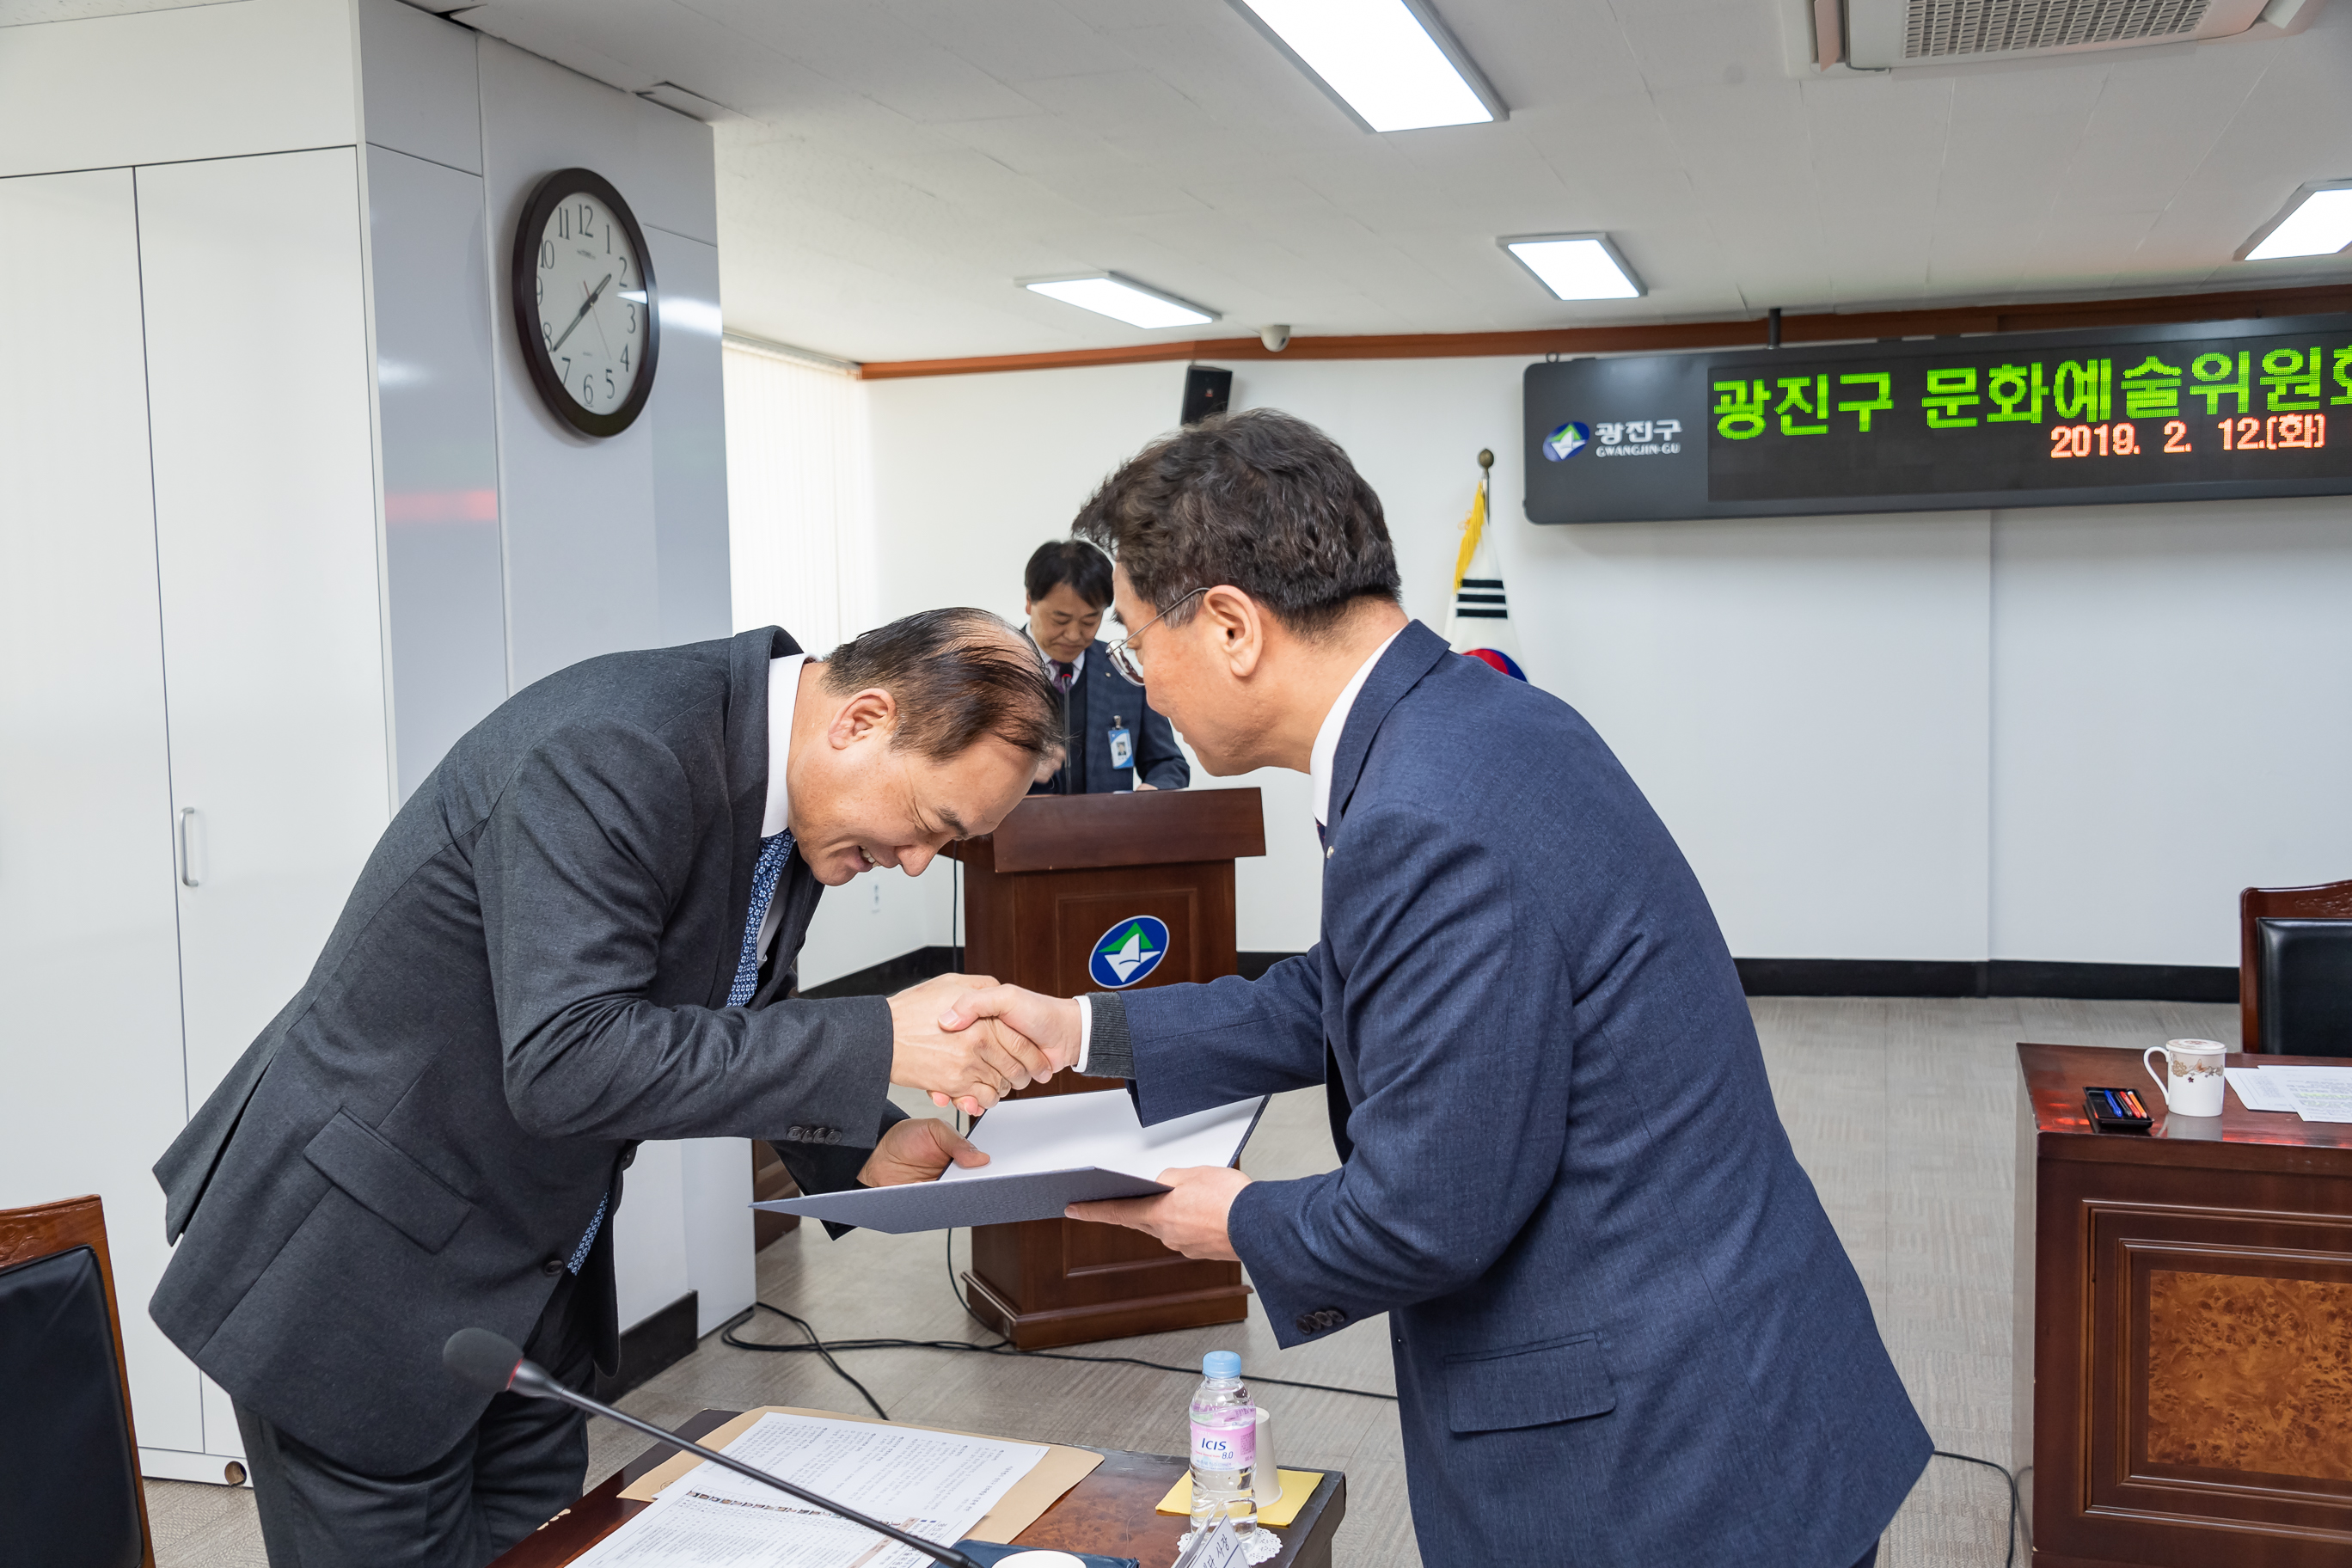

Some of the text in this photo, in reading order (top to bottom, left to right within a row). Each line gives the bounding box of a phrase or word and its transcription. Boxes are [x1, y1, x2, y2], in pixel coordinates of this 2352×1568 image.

[558, 205, 570, 241] 11
[579, 203, 594, 238] 12
[540, 238, 555, 270] 10
[606, 224, 611, 255] 1
[619, 255, 628, 288] 2
[626, 303, 636, 334] 3
[561, 356, 571, 387] 7
[620, 342, 630, 373] 4
[583, 373, 594, 405] 6
[605, 368, 616, 400] 5
[1713, 371, 1895, 440] 광진구
[1595, 419, 1683, 445] 광진구
[2050, 423, 2141, 458] 2019.
[2163, 420, 2192, 453] 2.
[1596, 442, 1681, 457] GWANGJIN-GU
[1222, 1451, 1234, 1460] 8.0
[1216, 1533, 1229, 1559] 사장
